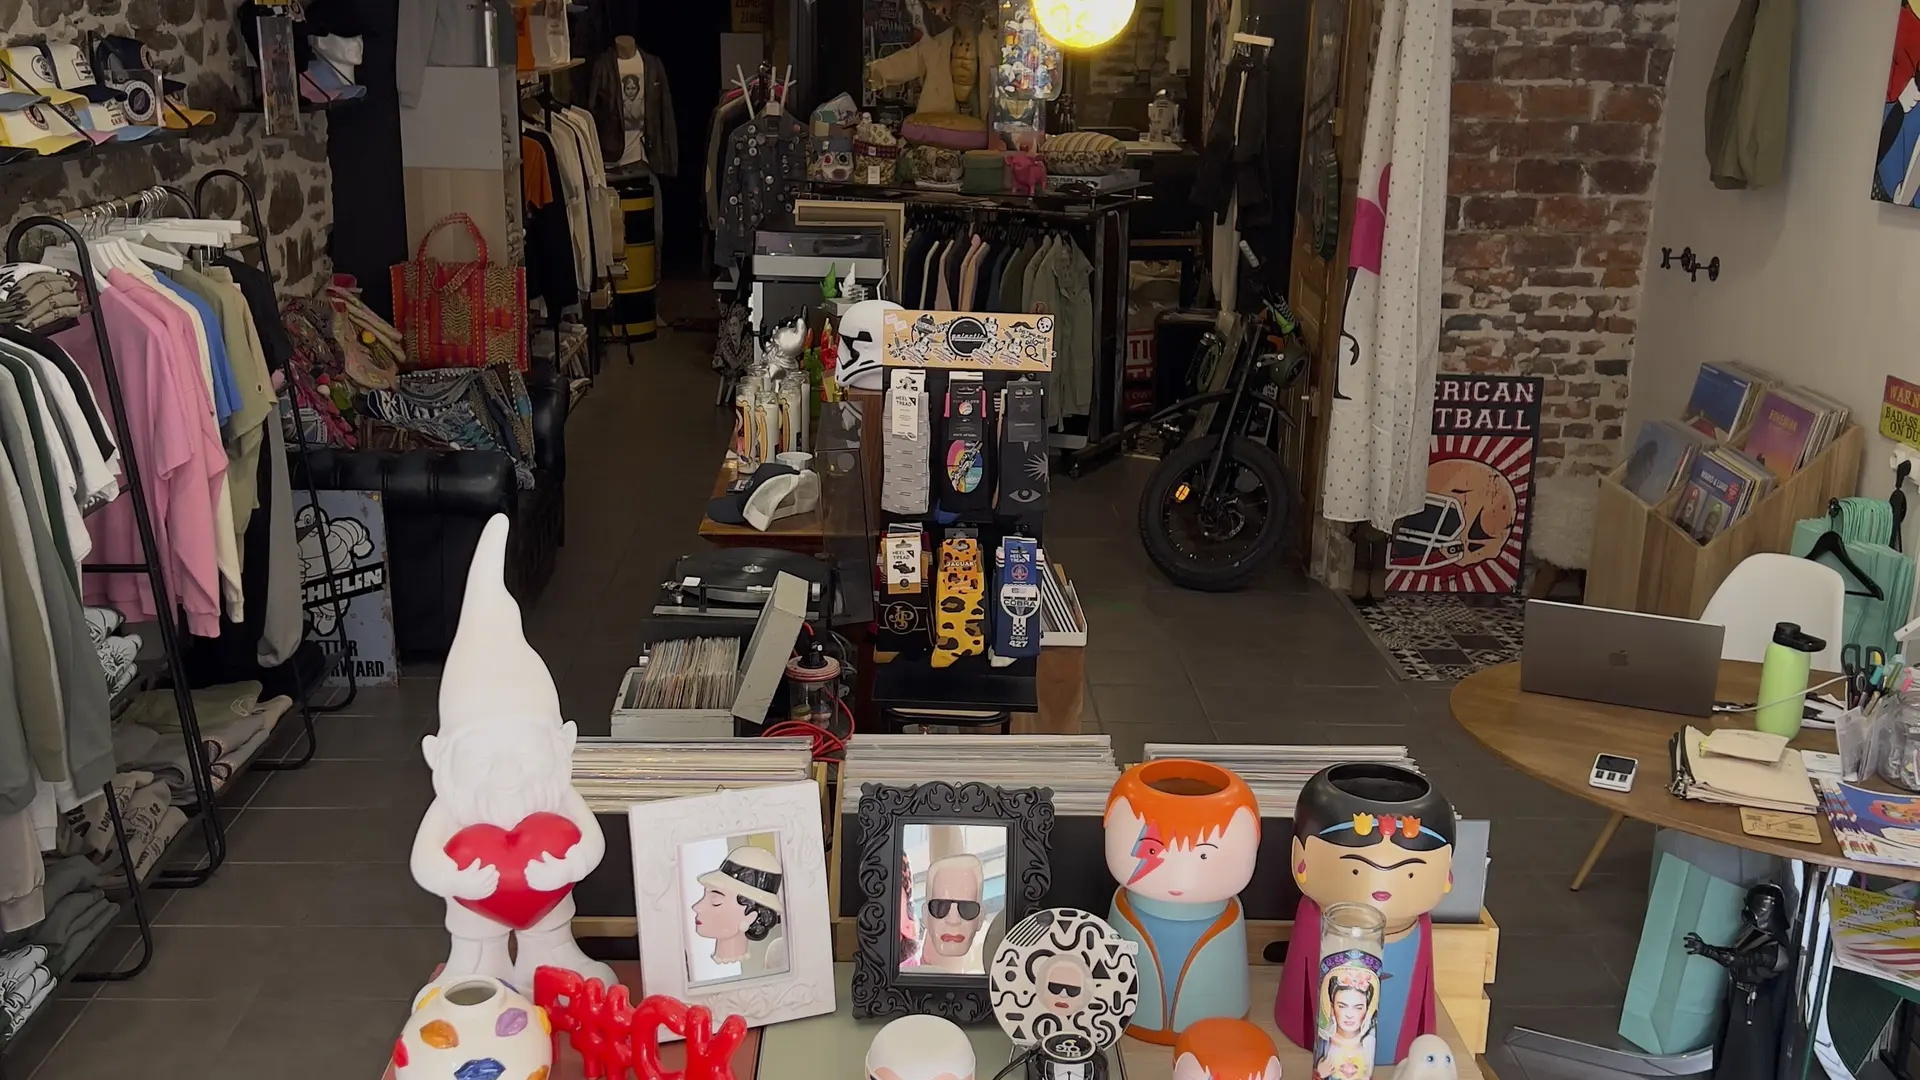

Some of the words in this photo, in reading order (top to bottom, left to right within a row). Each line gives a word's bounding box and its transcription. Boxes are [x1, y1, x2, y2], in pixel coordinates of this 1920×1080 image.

[1884, 406, 1919, 430] BADASS
[1890, 421, 1903, 437] ON
[1003, 598, 1037, 608] COBRA
[1008, 640, 1029, 649] 427
